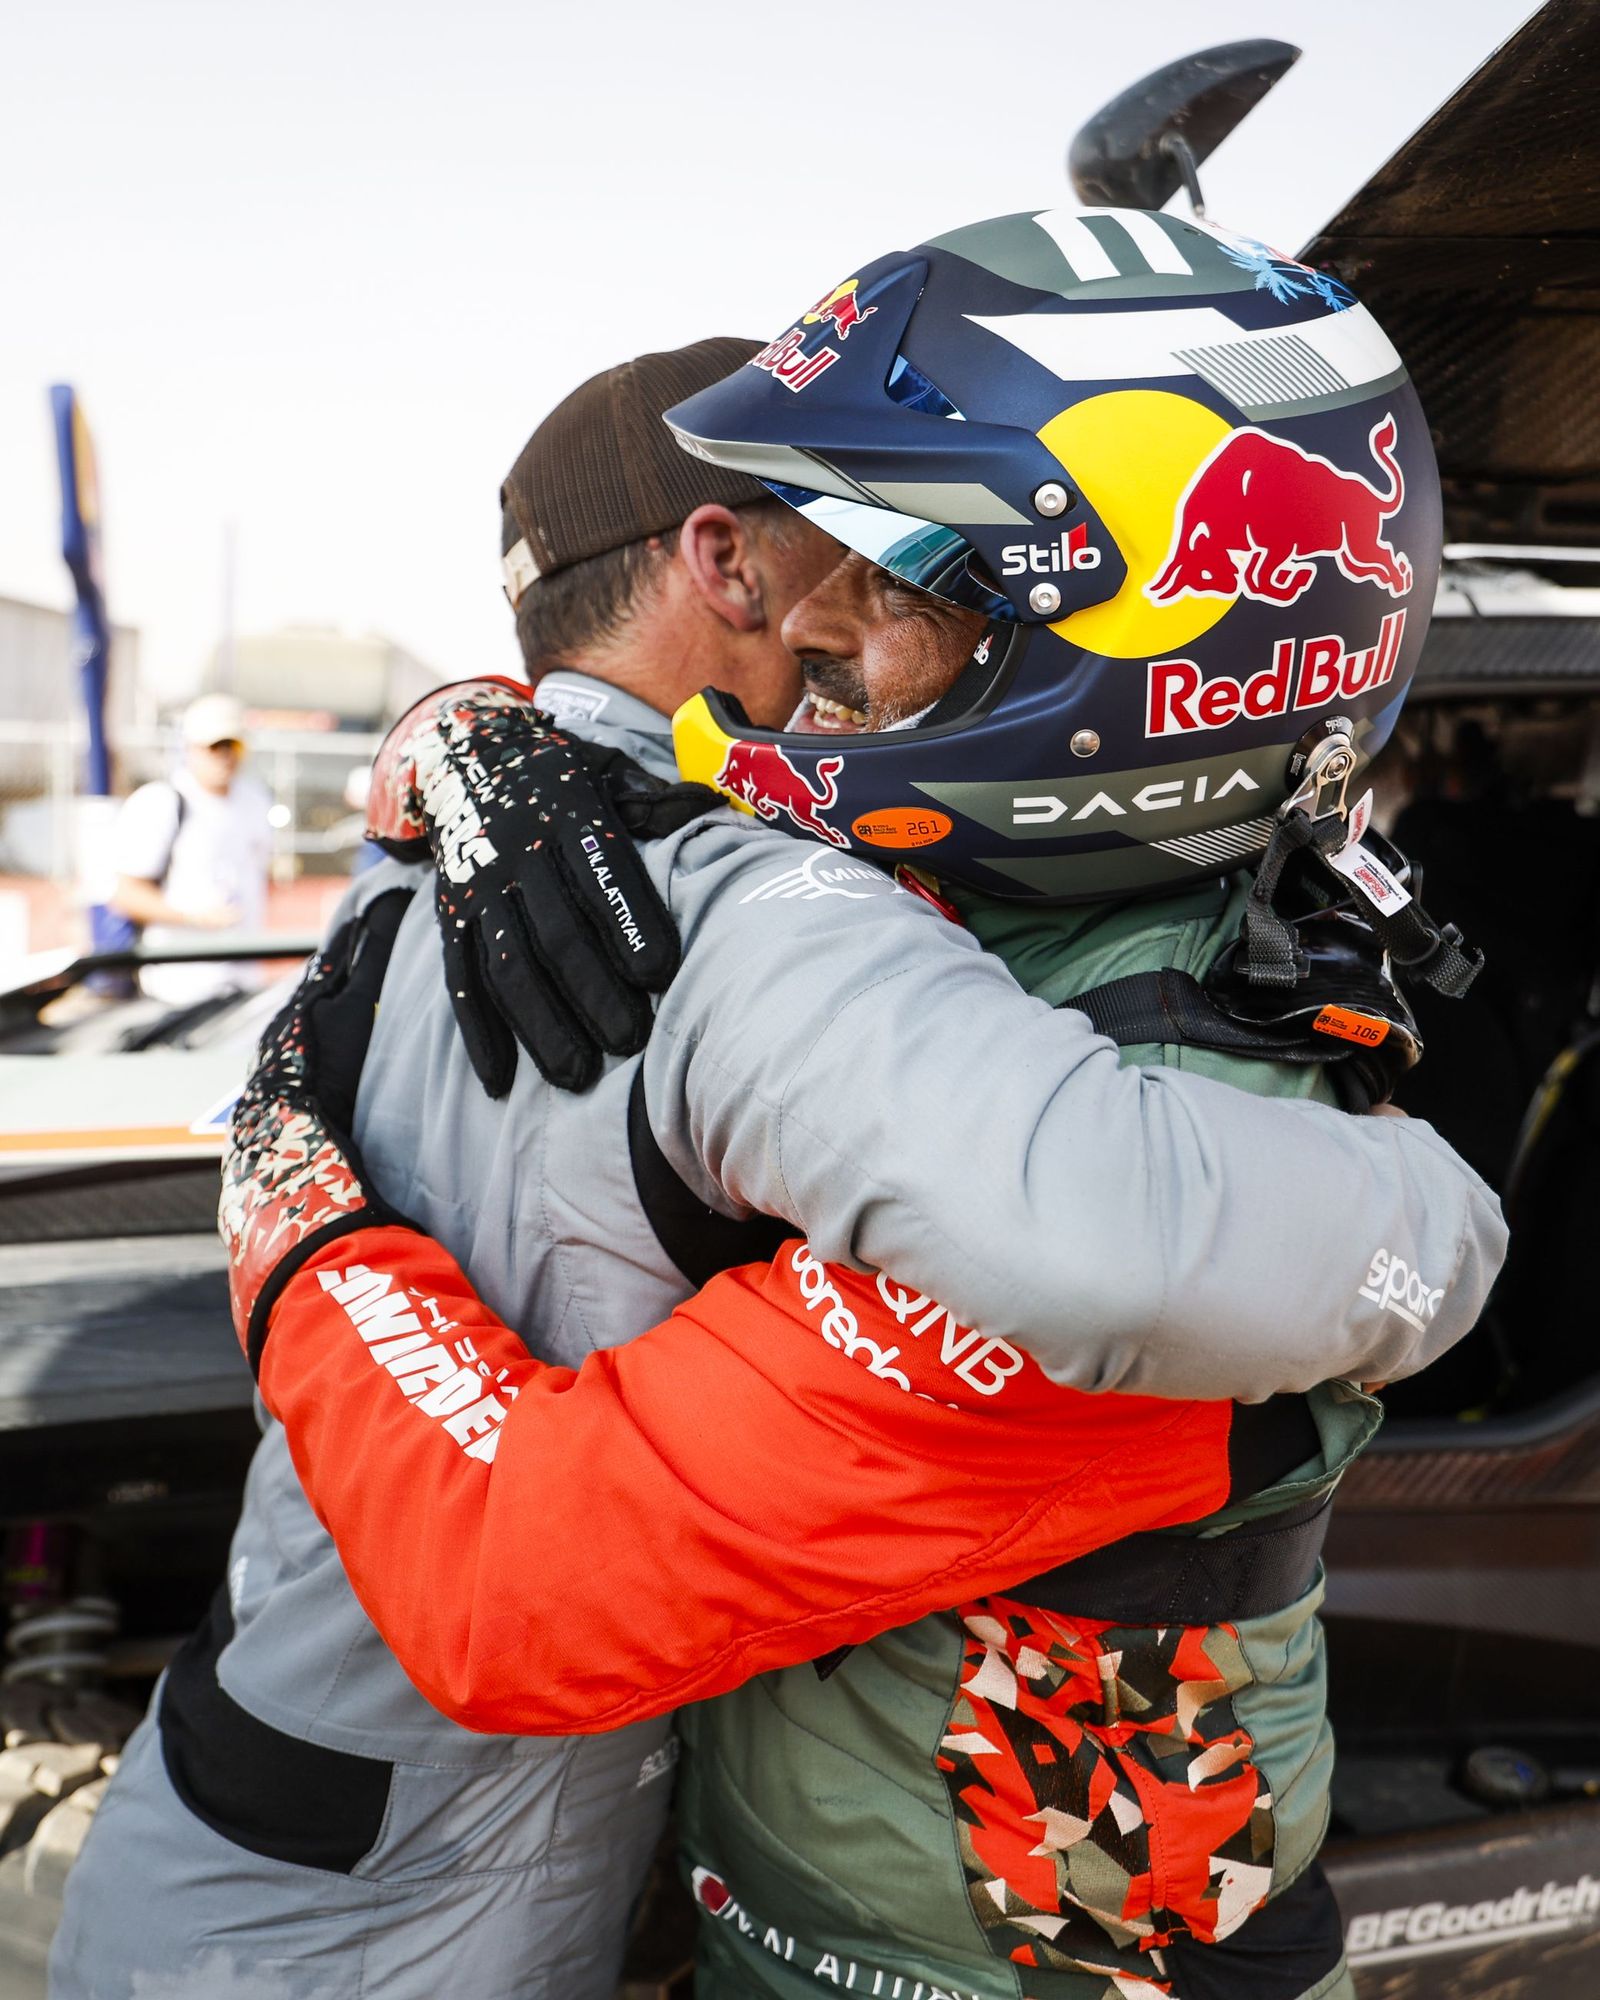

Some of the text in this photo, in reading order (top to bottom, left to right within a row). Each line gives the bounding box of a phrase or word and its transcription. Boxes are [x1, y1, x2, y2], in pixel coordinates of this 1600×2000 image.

[1012, 768, 1260, 825] DACIA
[906, 820, 941, 836] 261
[817, 867, 890, 884] MINI
[1350, 1023, 1380, 1041] 106
[875, 1270, 1024, 1396] QNB
[1345, 1874, 1600, 1953] BFGoodrich
